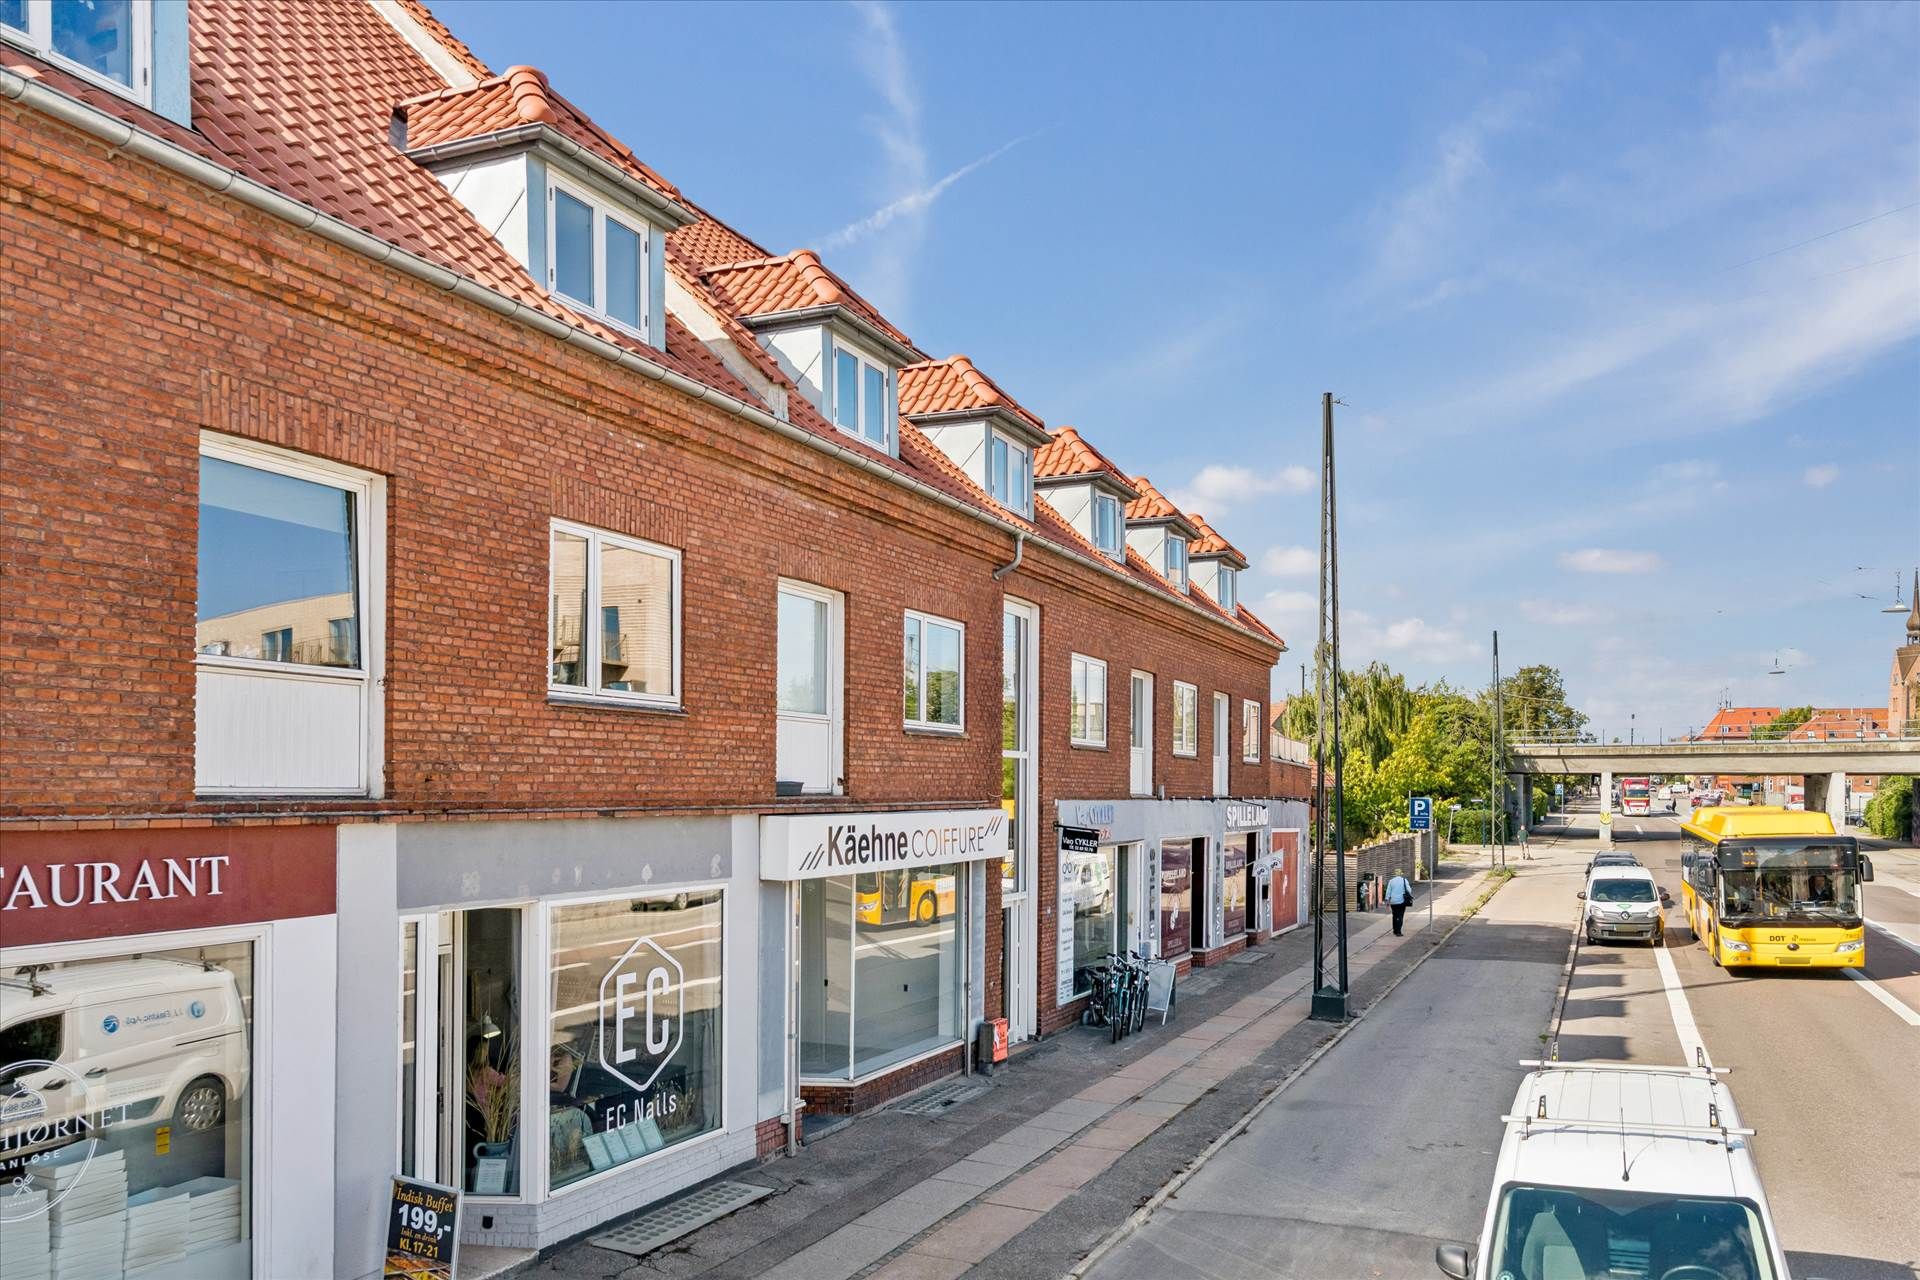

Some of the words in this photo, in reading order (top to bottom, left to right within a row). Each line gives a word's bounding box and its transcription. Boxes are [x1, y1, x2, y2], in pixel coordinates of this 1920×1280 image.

[827, 824, 908, 866] Käehne
[911, 825, 985, 858] COIFFURE
[0, 855, 229, 911] AURANT
[616, 966, 670, 1064] EC
[606, 1103, 626, 1134] EC
[634, 1091, 677, 1124] Nails
[396, 1187, 424, 1205] Indisk
[425, 1194, 454, 1214] Buffet
[398, 1203, 452, 1240] 199,-
[399, 1237, 412, 1251] Kl.
[413, 1240, 439, 1258] 17-21
